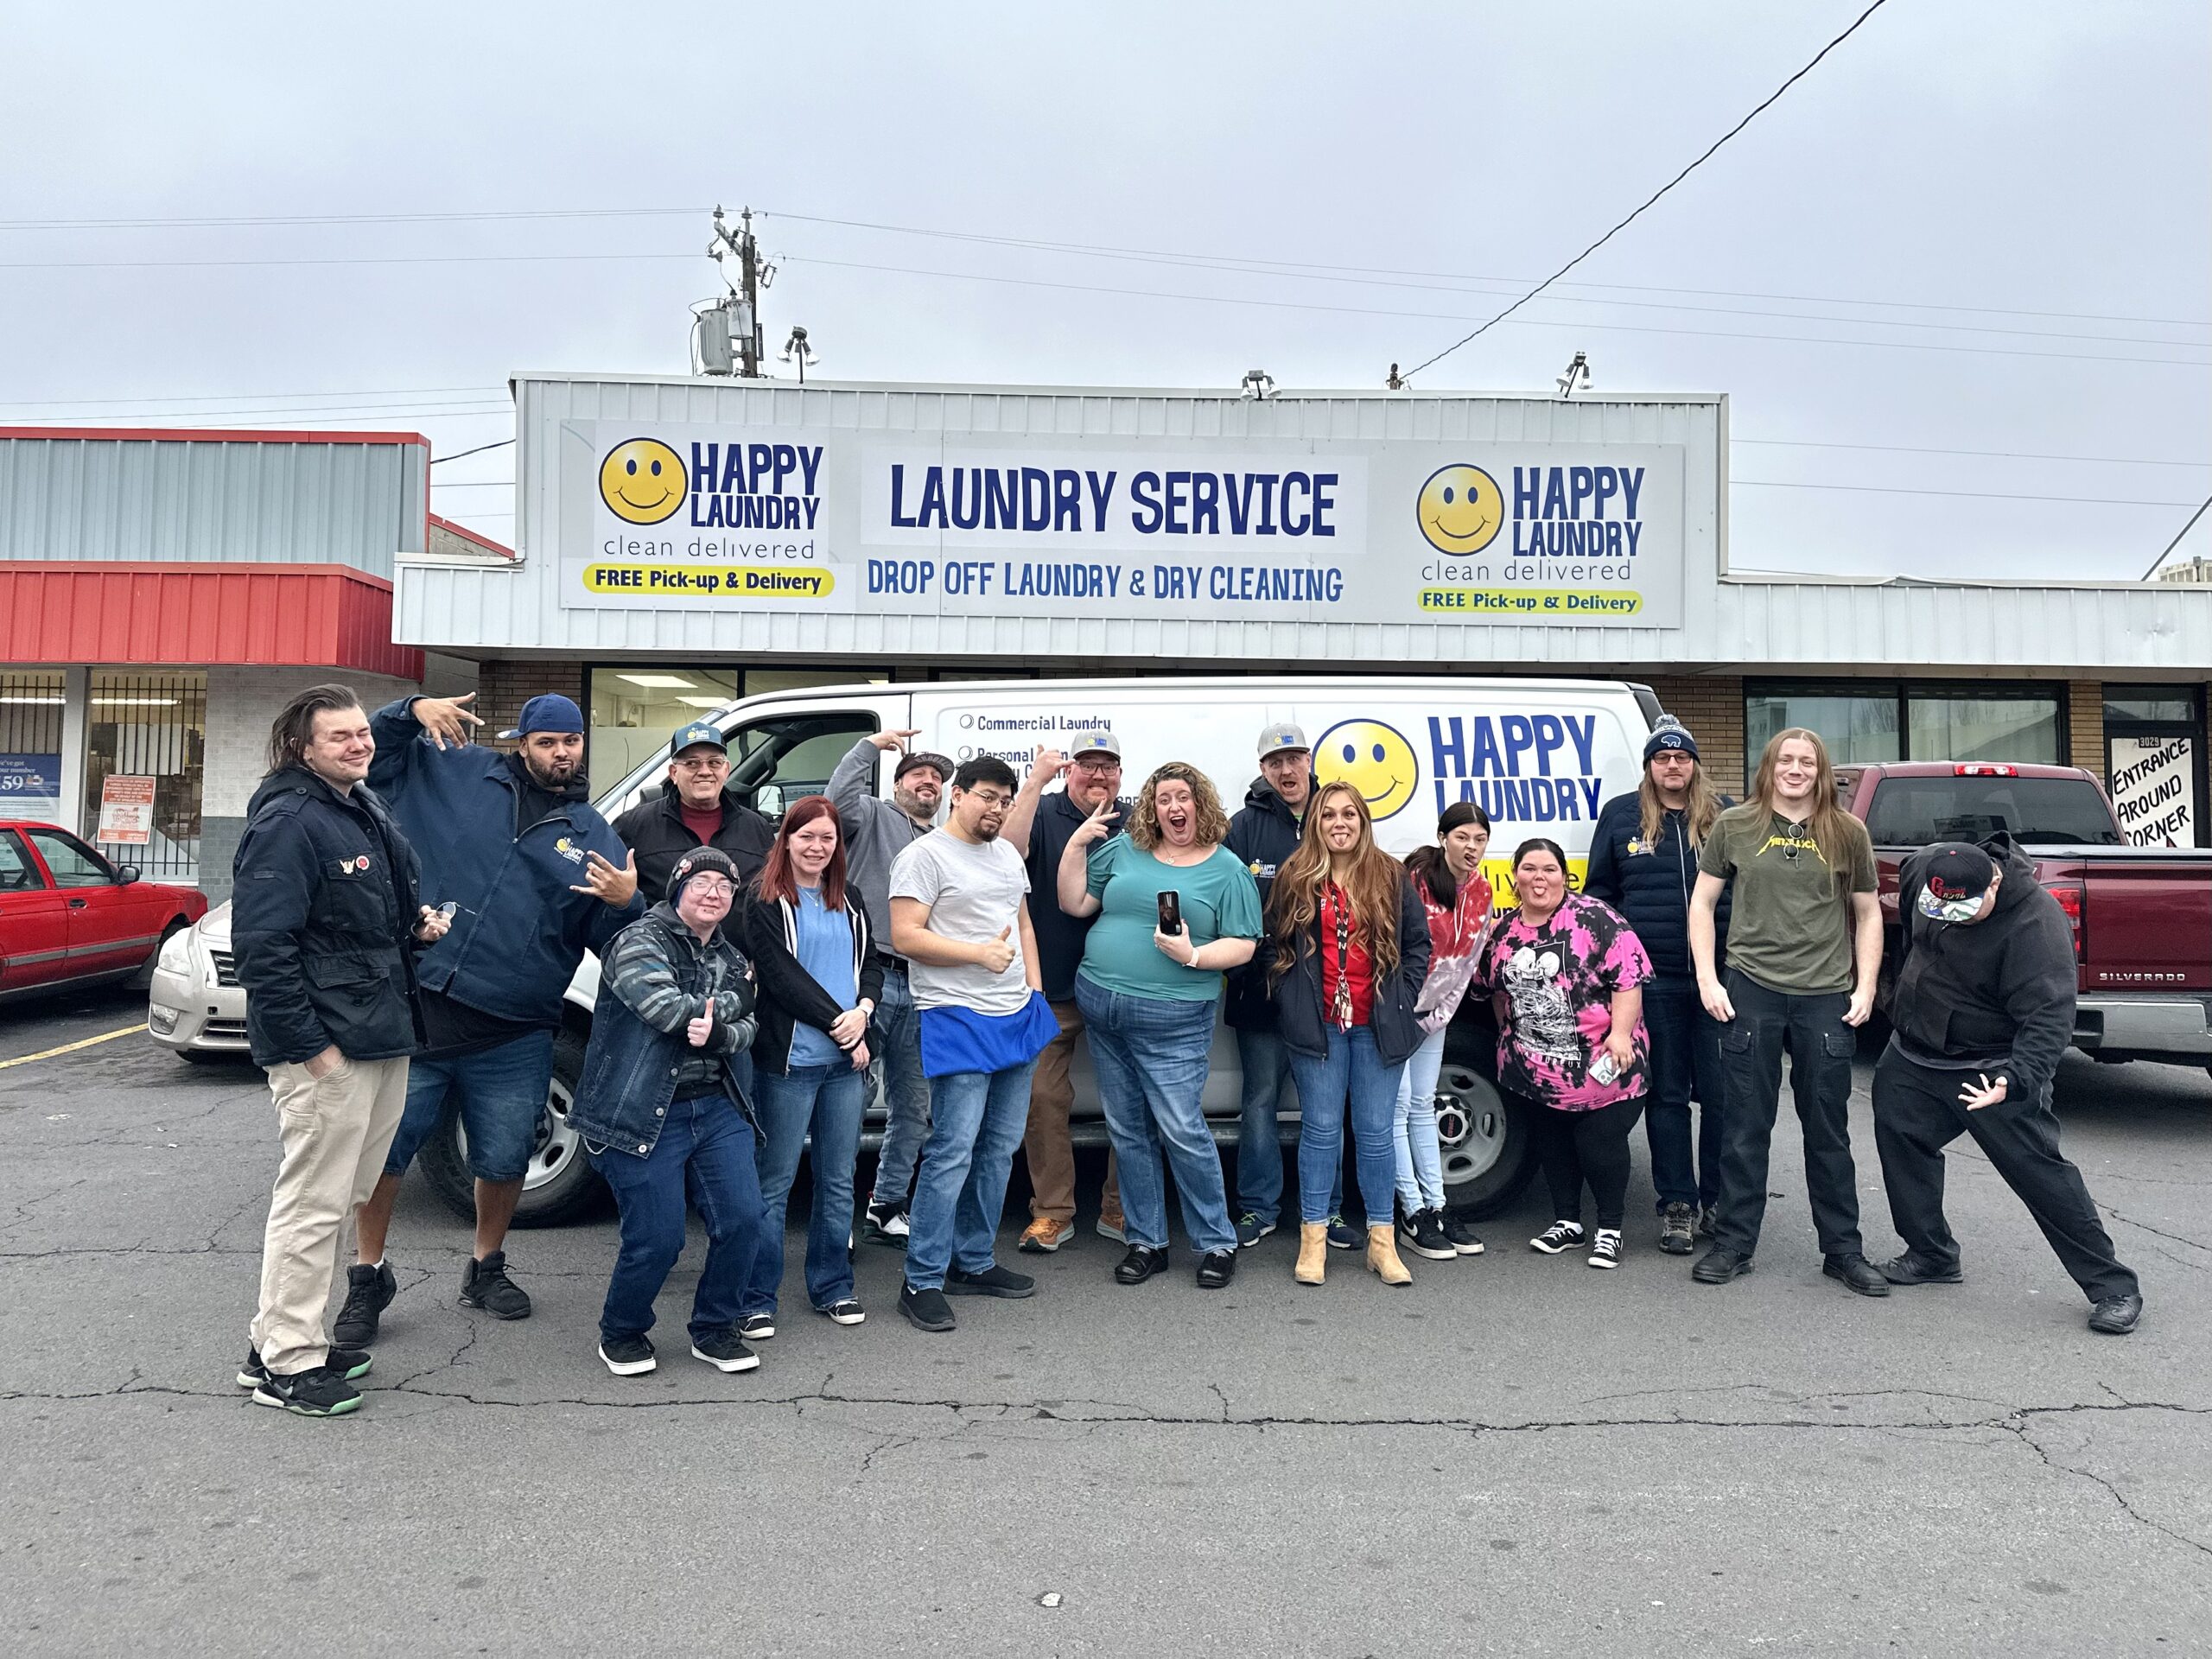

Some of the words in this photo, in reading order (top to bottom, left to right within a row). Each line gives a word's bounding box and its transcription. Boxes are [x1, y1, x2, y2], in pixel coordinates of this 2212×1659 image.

[691, 442, 823, 495] HAPPY
[891, 464, 1117, 532] LAUNDRY
[1131, 471, 1338, 537] SERVICE
[1513, 467, 1645, 520] HAPPY
[691, 494, 820, 530] LAUNDRY
[604, 535, 672, 556] clean
[688, 537, 814, 559] delivered
[1513, 520, 1643, 556] LAUNDRY
[595, 569, 642, 587] FREE
[650, 570, 719, 593] Pick-up
[726, 574, 740, 588] &
[747, 573, 822, 594] Delivery
[868, 559, 934, 594] DROP
[945, 561, 995, 595] OFF
[1005, 563, 1122, 598] LAUNDRY
[1129, 570, 1145, 596] &
[1154, 565, 1203, 600] DRY
[1211, 566, 1344, 601] CLEANING
[1421, 560, 1490, 580] clean
[1504, 560, 1631, 581] delivered
[1423, 593, 1465, 607] FREE
[1474, 594, 1537, 611] Pick-up
[1544, 596, 1560, 608] &
[1567, 595, 1637, 613] Delivery
[978, 715, 1055, 730] Commercial
[1060, 715, 1111, 732] Laundry
[2139, 736, 2160, 747] 3029
[1427, 715, 1596, 778] HAPPY
[2113, 738, 2190, 795] ENTRANCE
[1434, 778, 1602, 822] LAUNDRY
[2117, 774, 2182, 823] AROUND
[2099, 972, 2185, 982] SILVERADO
